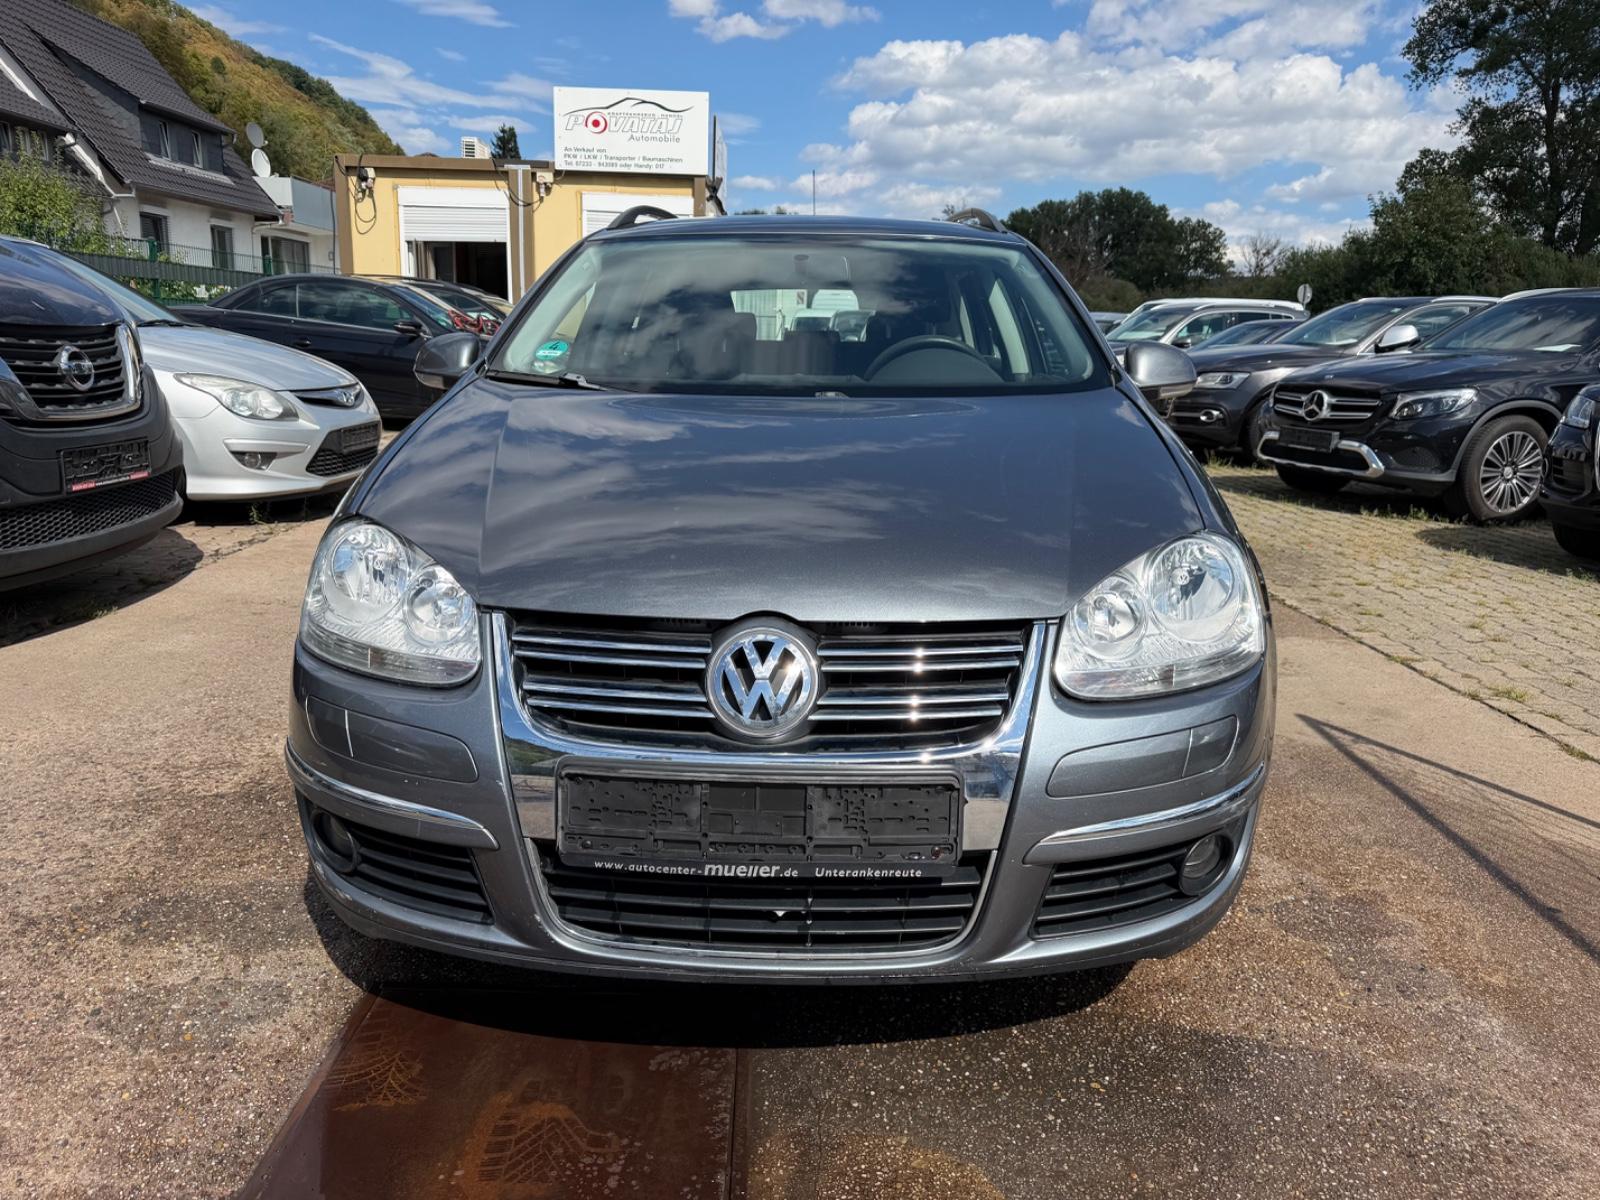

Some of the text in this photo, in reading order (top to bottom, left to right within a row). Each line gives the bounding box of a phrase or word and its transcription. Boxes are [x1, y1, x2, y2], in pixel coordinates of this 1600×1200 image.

[565, 112, 683, 134] POVATAJ
[628, 134, 680, 143] Automobile
[604, 154, 636, 162] Transporter
[642, 155, 683, 163] Baumaschinen
[712, 632, 813, 732] VW
[594, 860, 922, 879] www.autocenter-mueller.de Unterankenreute
